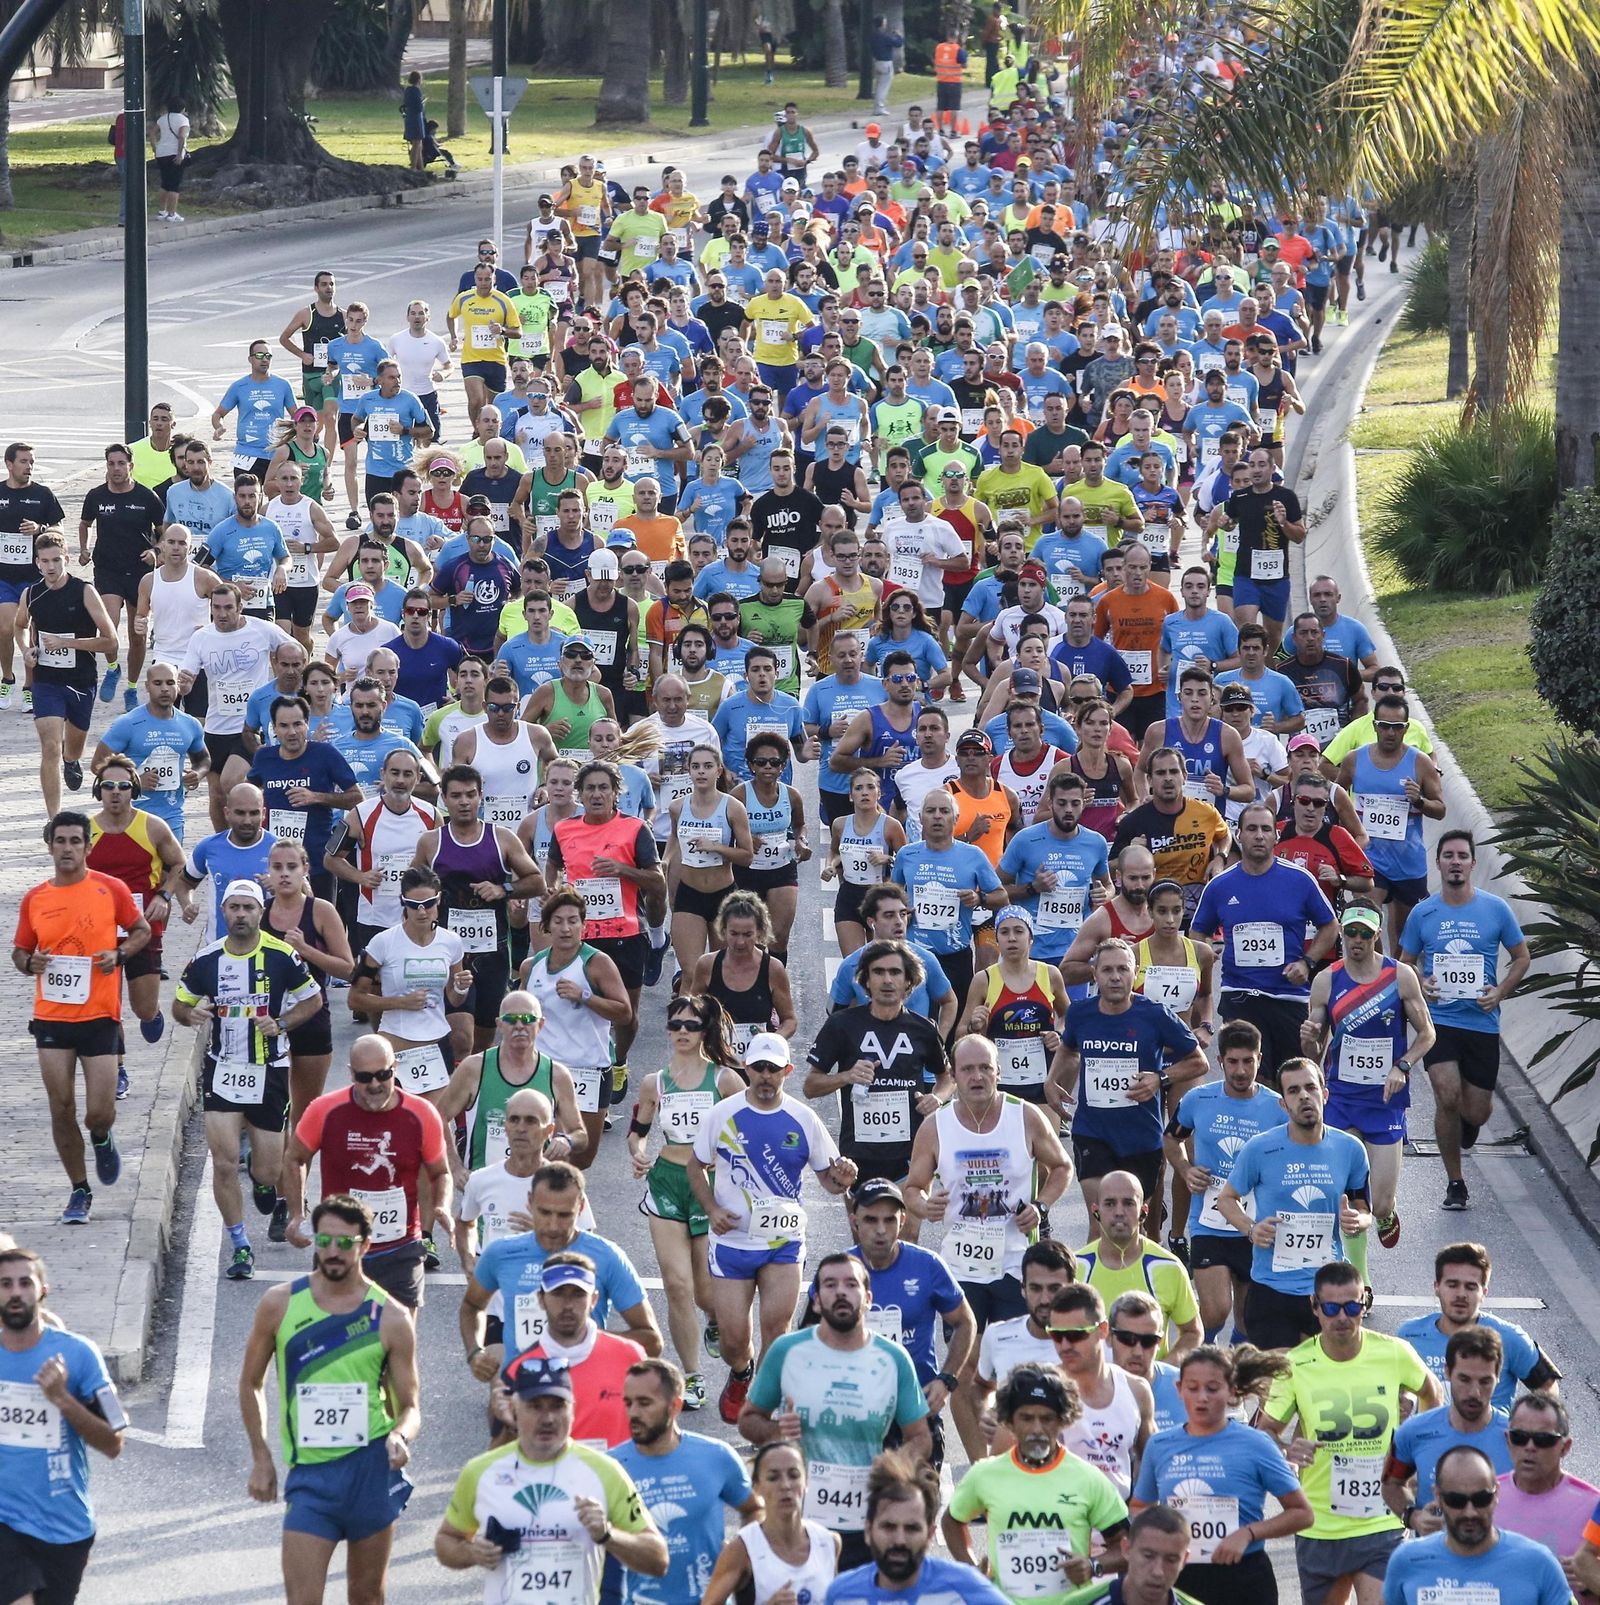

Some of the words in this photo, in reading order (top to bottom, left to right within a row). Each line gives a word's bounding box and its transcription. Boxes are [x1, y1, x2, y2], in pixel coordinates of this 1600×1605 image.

[594, 513, 613, 523] 6171
[767, 511, 801, 528] JUDO
[178, 519, 211, 532] nerja
[1143, 534, 1164, 543] 6019
[3, 544, 27, 555] 8662
[896, 546, 921, 554] XXIV
[893, 566, 919, 579] 13833
[1258, 561, 1279, 570] 1953
[1127, 663, 1149, 673] 527
[222, 693, 250, 705] 3642
[1304, 718, 1336, 734] 13174
[267, 777, 311, 791] mayoral
[491, 810, 522, 821] 3302
[1370, 813, 1400, 827] 9036
[274, 826, 303, 840] 18066
[1151, 832, 1206, 848] bichos
[843, 837, 872, 846] nerja
[764, 847, 779, 858] 94
[852, 861, 868, 872] 39
[916, 902, 956, 918] 15372
[1044, 901, 1081, 915] 18508
[1242, 938, 1276, 952] 2934
[48, 973, 82, 988] 8697
[1442, 972, 1476, 984] 1039
[1162, 985, 1179, 998] 74
[1346, 1006, 1381, 1031] RUNNERS
[1004, 1021, 1041, 1032] Málaga
[1083, 1039, 1138, 1053] mayoral
[1011, 1057, 1030, 1069] 64
[1348, 1055, 1384, 1069] 1535
[411, 1065, 429, 1080] 92
[222, 1073, 256, 1088] 2188
[1093, 1077, 1130, 1091] 1493
[672, 1112, 699, 1126] 515
[863, 1111, 900, 1125] 8605
[967, 1159, 999, 1169] VUELA
[760, 1215, 799, 1229] 2108
[1285, 1233, 1323, 1249] 3757
[955, 1242, 994, 1261] 1920
[0, 1407, 48, 1425] 3824
[314, 1409, 350, 1426] 287
[1312, 1385, 1389, 1442] 35
[1337, 1479, 1381, 1498] 1832
[817, 1488, 863, 1508] 9441
[519, 1523, 568, 1541] Unicaja
[1191, 1521, 1227, 1539] 600
[1011, 1556, 1060, 1574] 3693
[521, 1570, 573, 1591] 2947
